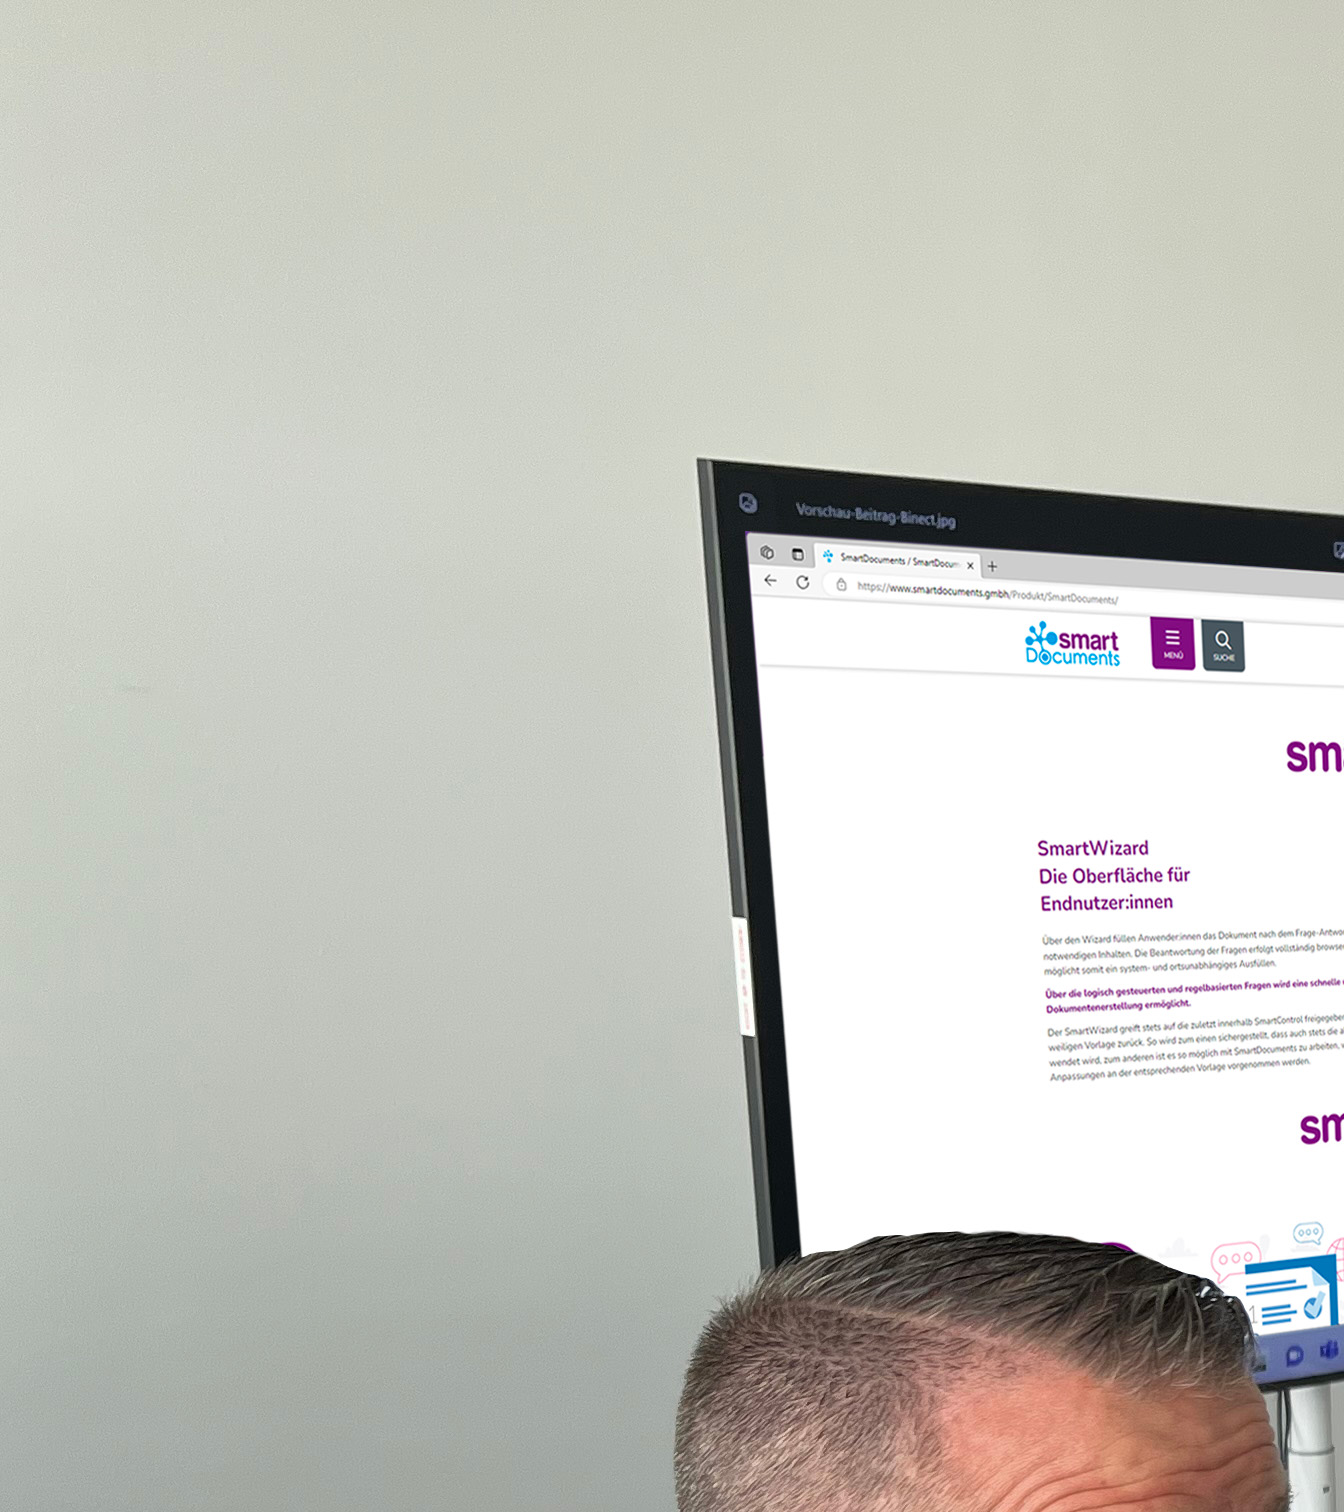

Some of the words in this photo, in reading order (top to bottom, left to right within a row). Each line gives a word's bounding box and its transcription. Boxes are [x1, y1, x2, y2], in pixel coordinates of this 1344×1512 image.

[841, 552, 906, 565] SmartDocuments
[858, 582, 1118, 605] https://www.smartdocuments.gmbh/Produkt/SmartDocuments/
[1059, 631, 1119, 653] smart
[1164, 651, 1184, 659] MENÜ
[1213, 652, 1235, 662] SUCHE
[1038, 840, 1148, 856] SmartWizard
[1040, 868, 1067, 884] Die
[1073, 868, 1162, 884] Oberfläche
[1167, 867, 1190, 882] für
[1041, 894, 1172, 911] Endnutzer:innen
[1042, 935, 1062, 945] Über
[1064, 936, 1080, 944] den
[1082, 935, 1112, 944] Wizard
[1113, 935, 1136, 943] füllen
[1138, 934, 1201, 942] Anwender:innen
[1202, 932, 1216, 940] das
[1218, 931, 1257, 940] Dokument
[1258, 930, 1276, 938] nach
[1278, 930, 1294, 938] dem
[1043, 952, 1097, 961] notwendigen
[1134, 949, 1148, 958] Die
[1150, 948, 1205, 957] Beantwortung
[1206, 947, 1219, 955] der
[1221, 946, 1247, 956] Fragen
[1248, 945, 1274, 954] erfolgt
[1275, 944, 1315, 953] vollständig
[1044, 966, 1080, 977] möglicht
[1082, 966, 1104, 974] somit
[1105, 965, 1118, 974] ein
[1152, 963, 1168, 971] und
[1169, 961, 1237, 971] ortsunabhängiges
[1046, 988, 1066, 999] Über
[1068, 989, 1082, 998] die
[1084, 988, 1114, 998] logisch
[1116, 987, 1166, 998] gesteuerten
[1167, 985, 1183, 993] und
[1185, 983, 1242, 994] regelbasierten
[1244, 982, 1271, 991] Fragen
[1273, 980, 1290, 988] wird
[1292, 980, 1308, 988] eine
[1310, 978, 1340, 987] schnelle
[1046, 1002, 1143, 1014] Dokumentenerstellung
[1048, 1028, 1062, 1037] Der
[1064, 1026, 1118, 1036] SmartWizard
[1119, 1024, 1140, 1034] greift
[1142, 1024, 1161, 1032] stets
[1163, 1022, 1176, 1030] auf
[1177, 1022, 1189, 1030] die
[1191, 1021, 1216, 1029] zuletzt
[1218, 1018, 1253, 1027] innerhalb
[1254, 1016, 1303, 1026] SmartControl
[1048, 1042, 1083, 1052] weiligen
[1084, 1041, 1116, 1050] Vorlage
[1146, 1037, 1158, 1046] So
[1159, 1036, 1176, 1044] wird
[1195, 1035, 1217, 1043] einen
[1271, 1031, 1288, 1039] dass
[1290, 1029, 1307, 1037] auch
[1049, 1058, 1080, 1067] wendet
[1104, 1056, 1120, 1064] zum
[1122, 1054, 1154, 1062] anderen
[1188, 1049, 1218, 1059] möglich
[1234, 1045, 1297, 1056] SmartDocuments
[1050, 1072, 1105, 1082] Anpassungen
[1118, 1069, 1132, 1077] der
[1133, 1065, 1195, 1076] entsprechenden
[1196, 1064, 1226, 1072] Vorlage
[1227, 1060, 1280, 1071] vorgenommen
